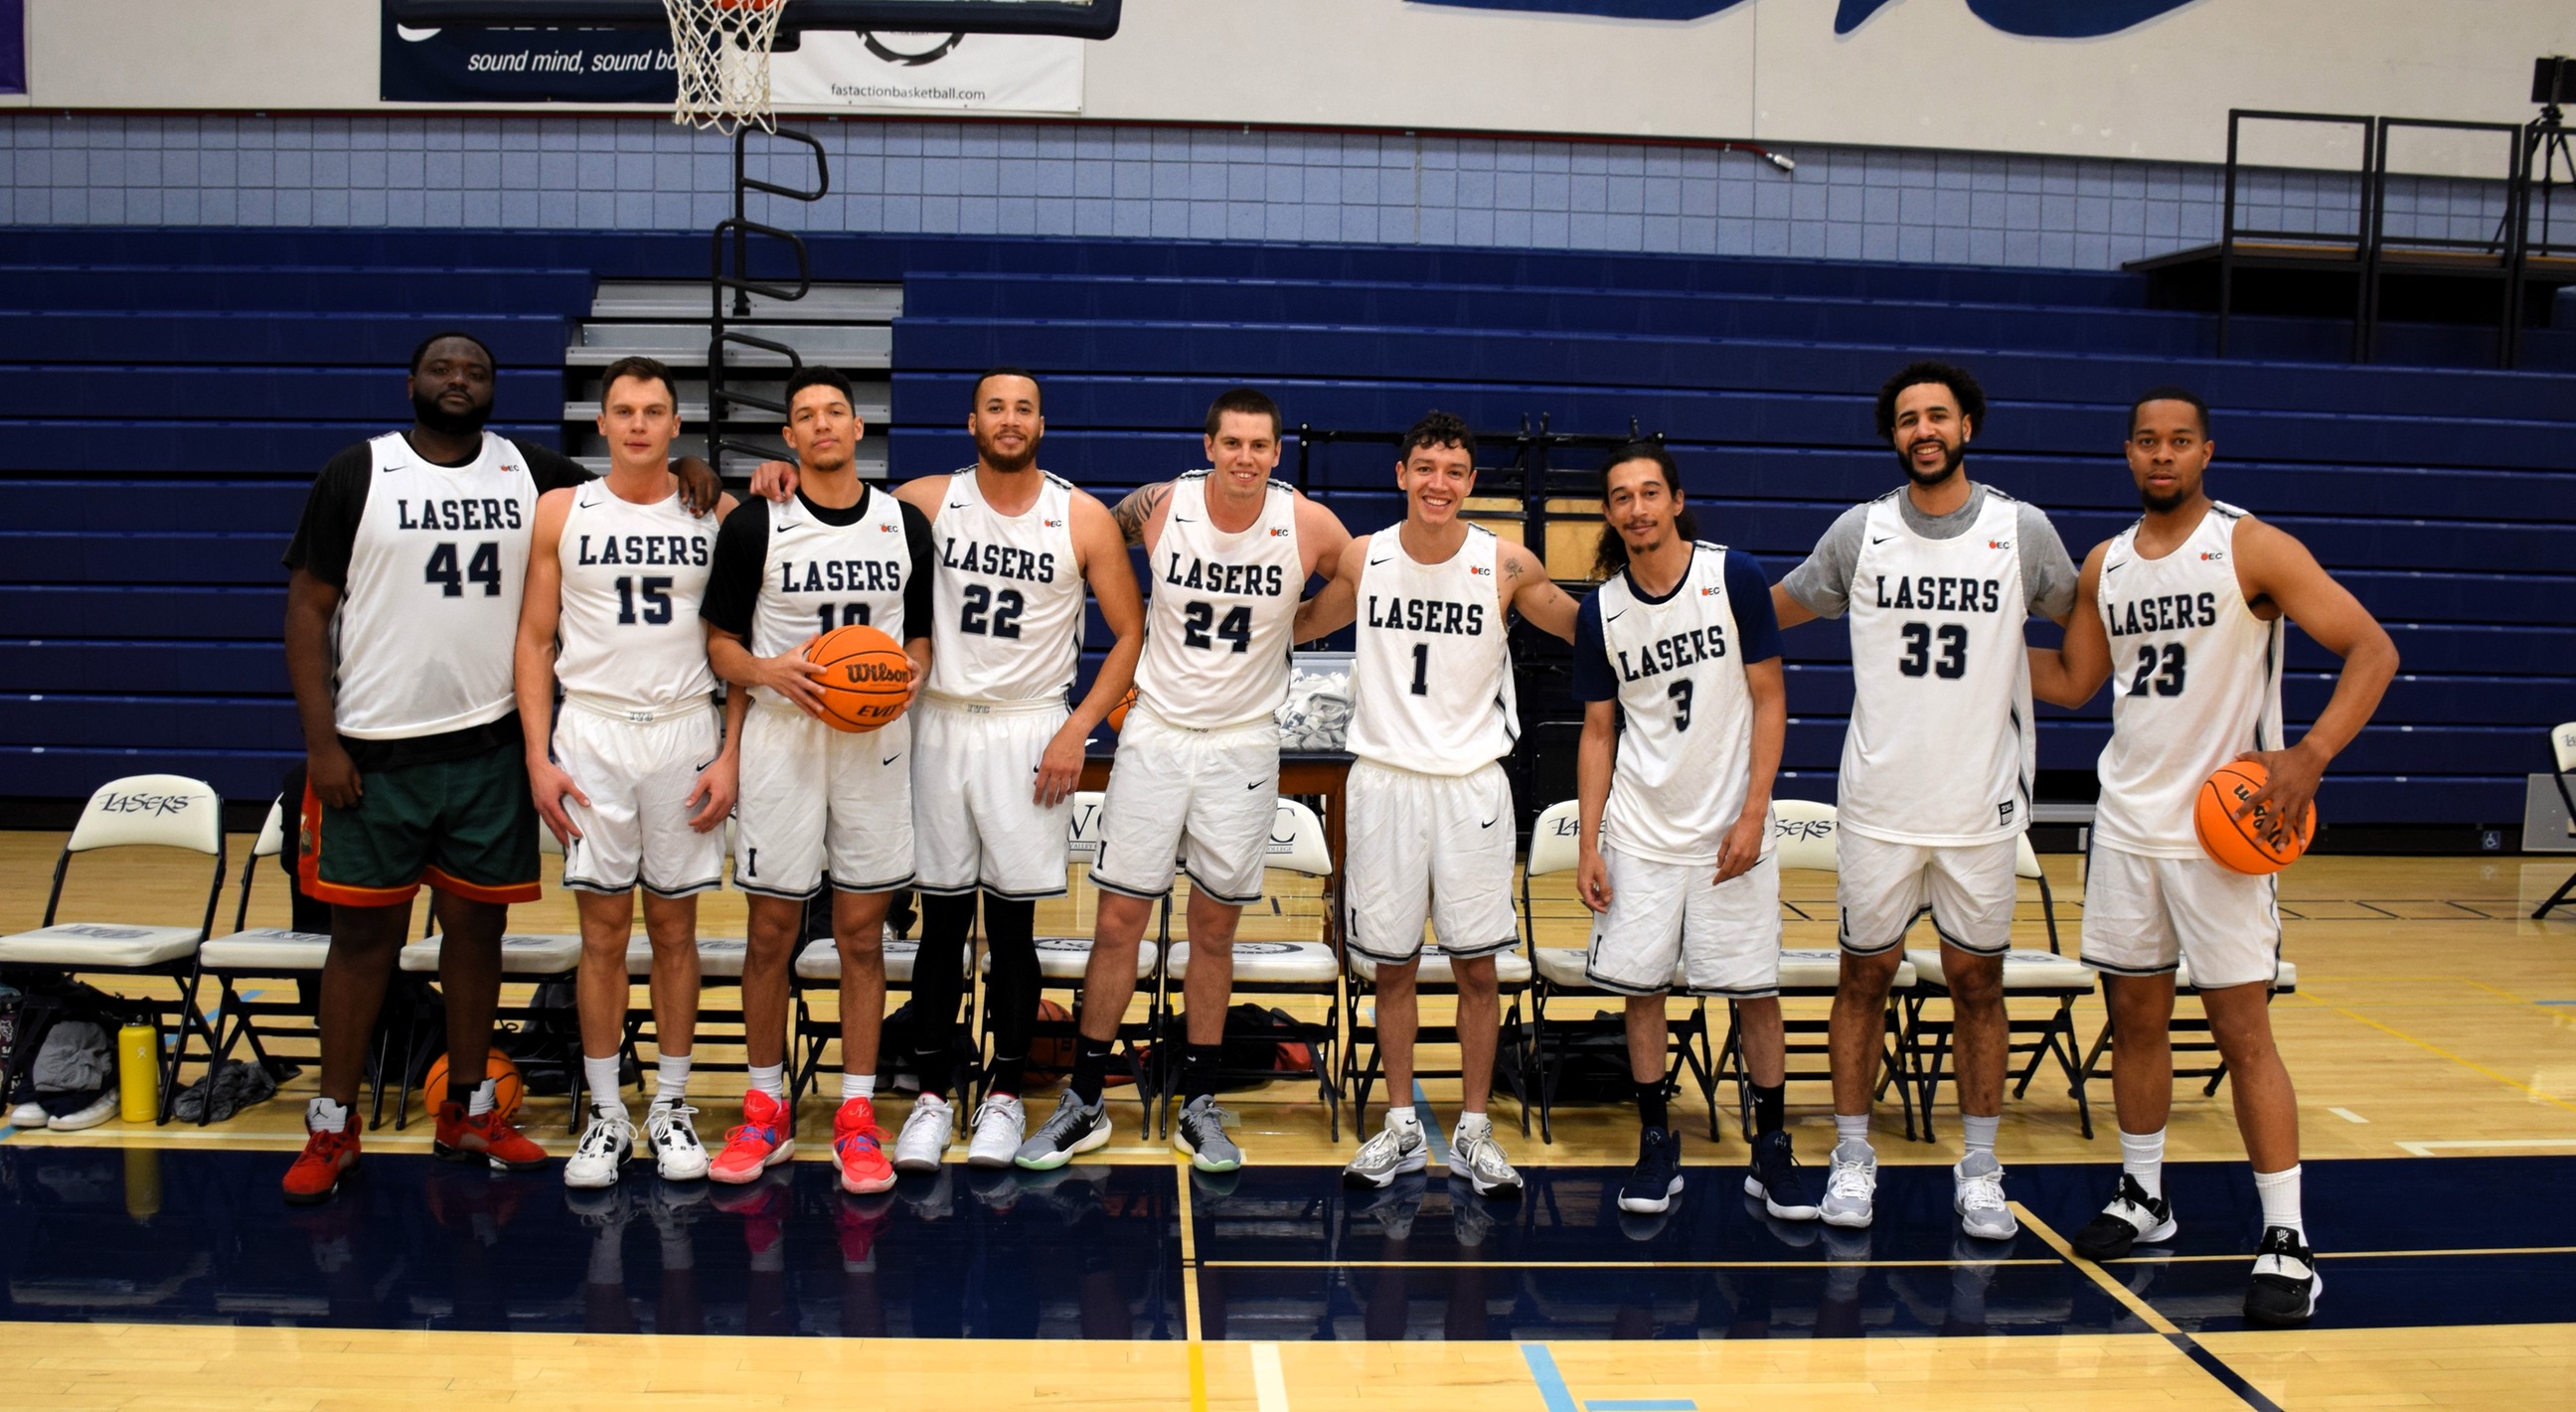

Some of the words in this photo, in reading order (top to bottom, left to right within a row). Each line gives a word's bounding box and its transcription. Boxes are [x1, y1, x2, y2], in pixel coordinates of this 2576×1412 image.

[467, 50, 529, 72] sound
[531, 50, 585, 75] mind,
[590, 49, 652, 72] sound
[831, 83, 986, 100] fastactionbasketball.com
[398, 498, 522, 531] LASERS
[424, 541, 502, 598] 44
[578, 535, 709, 566] LASERS
[942, 538, 1055, 584] LASERS
[781, 560, 900, 592] LASERS
[1166, 551, 1283, 596] LASERS
[1875, 575, 2000, 613] LASERS
[614, 574, 677, 626] 15
[960, 583, 1025, 640] 22
[1368, 595, 1485, 636] LASERS
[2107, 591, 2216, 636] LASERS
[1183, 599, 1253, 654] 24
[846, 662, 907, 684] Wilson
[1409, 642, 1430, 697] 1
[1618, 625, 1726, 683] LASERS
[1898, 621, 1969, 680] 33
[2125, 641, 2187, 698] 23
[967, 704, 991, 713] IVC
[1667, 677, 1693, 733] 3
